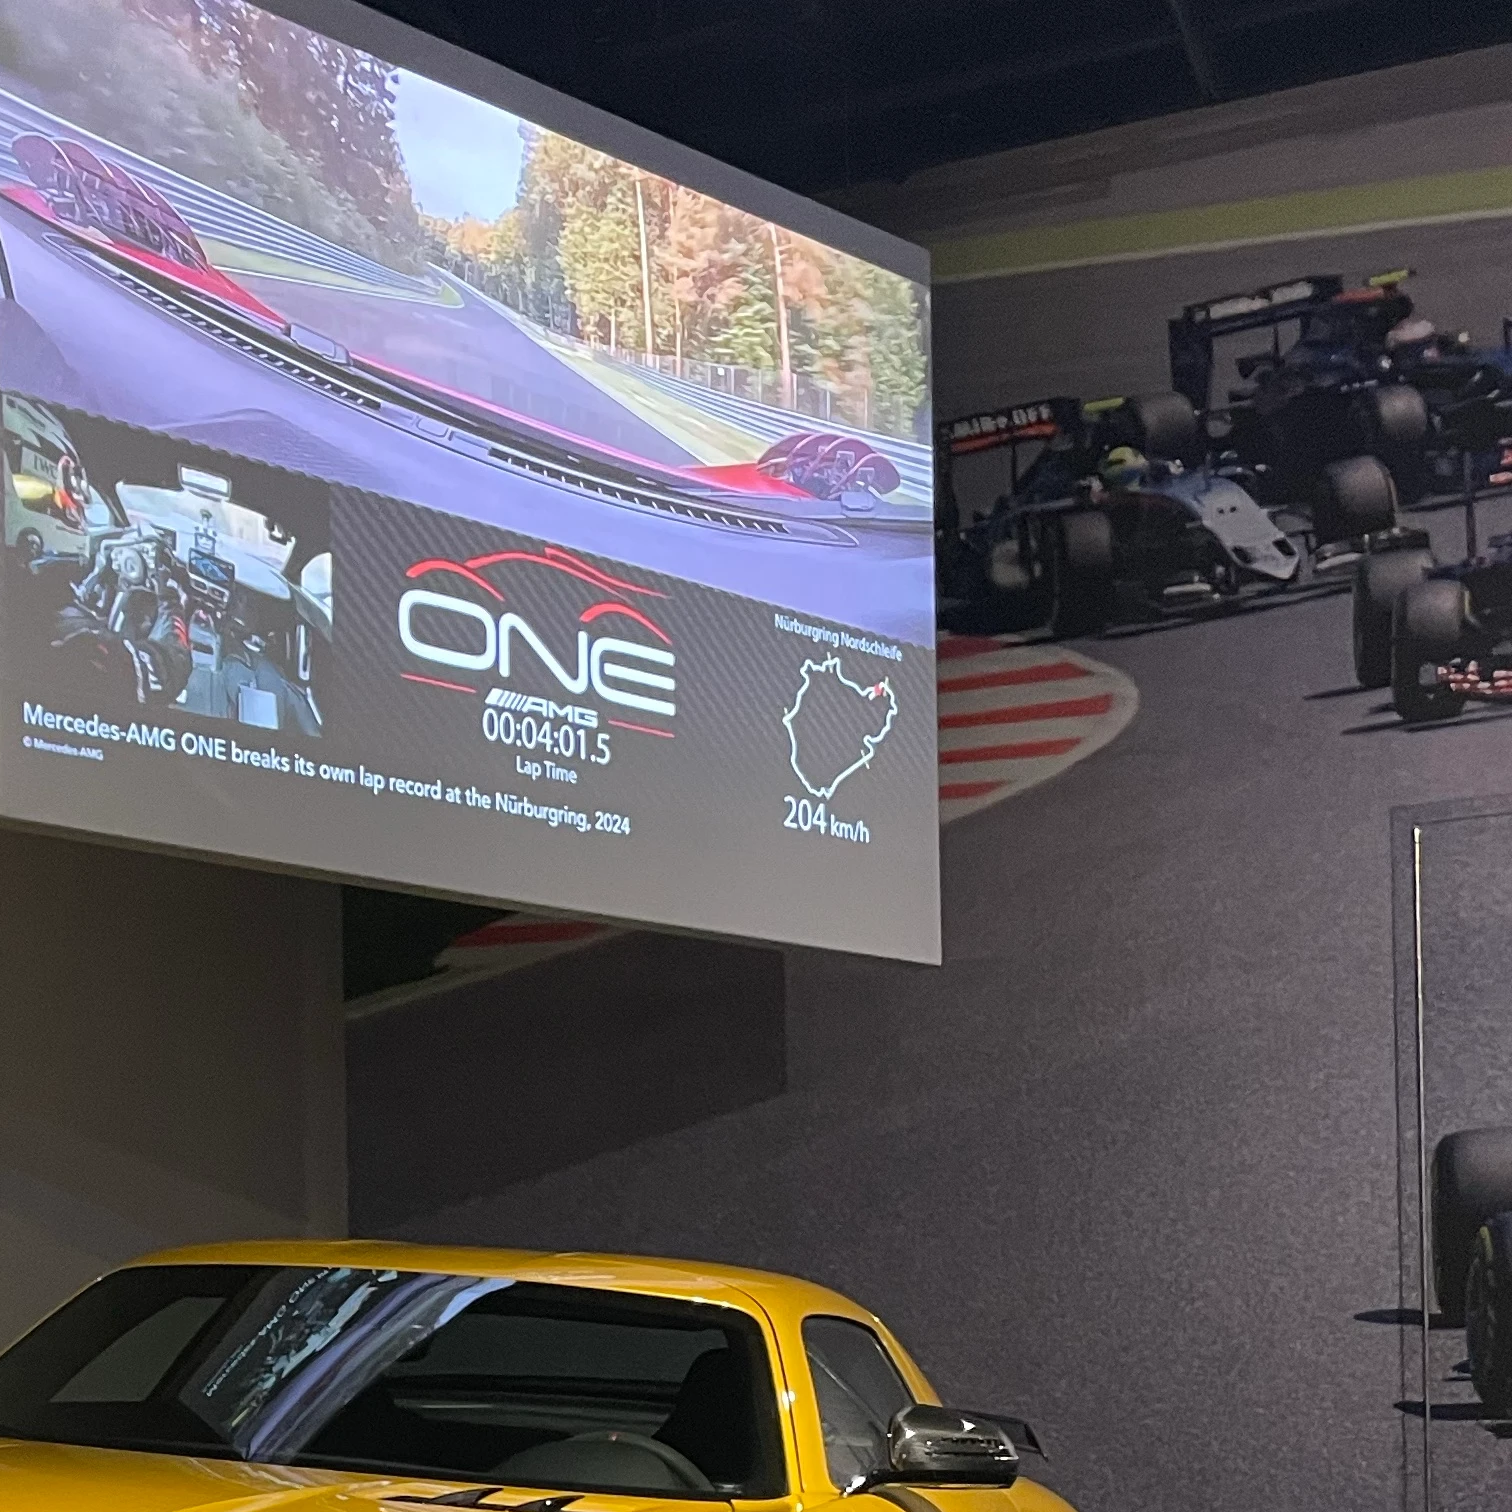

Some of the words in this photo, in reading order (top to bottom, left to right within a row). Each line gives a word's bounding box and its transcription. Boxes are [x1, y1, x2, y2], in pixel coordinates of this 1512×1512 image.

[398, 589, 676, 716] ONE
[774, 613, 840, 648] Nürburgring
[841, 632, 903, 662] Nordschleife
[482, 708, 611, 765] 00:04:01.5
[520, 695, 599, 729] AMG
[23, 701, 176, 751] Mercedes-AMG
[181, 732, 227, 761] ONE
[231, 740, 290, 773] breaks
[294, 753, 315, 777] its
[319, 763, 356, 784] own
[359, 765, 385, 795] lap
[389, 777, 442, 800] record
[445, 787, 462, 804] at
[465, 786, 492, 809] the
[495, 792, 592, 833] Nürburgring,
[594, 811, 631, 835] 2024
[516, 755, 542, 780] Lap
[543, 760, 578, 784] Time
[783, 795, 828, 835] 204
[830, 814, 870, 844] km/h
